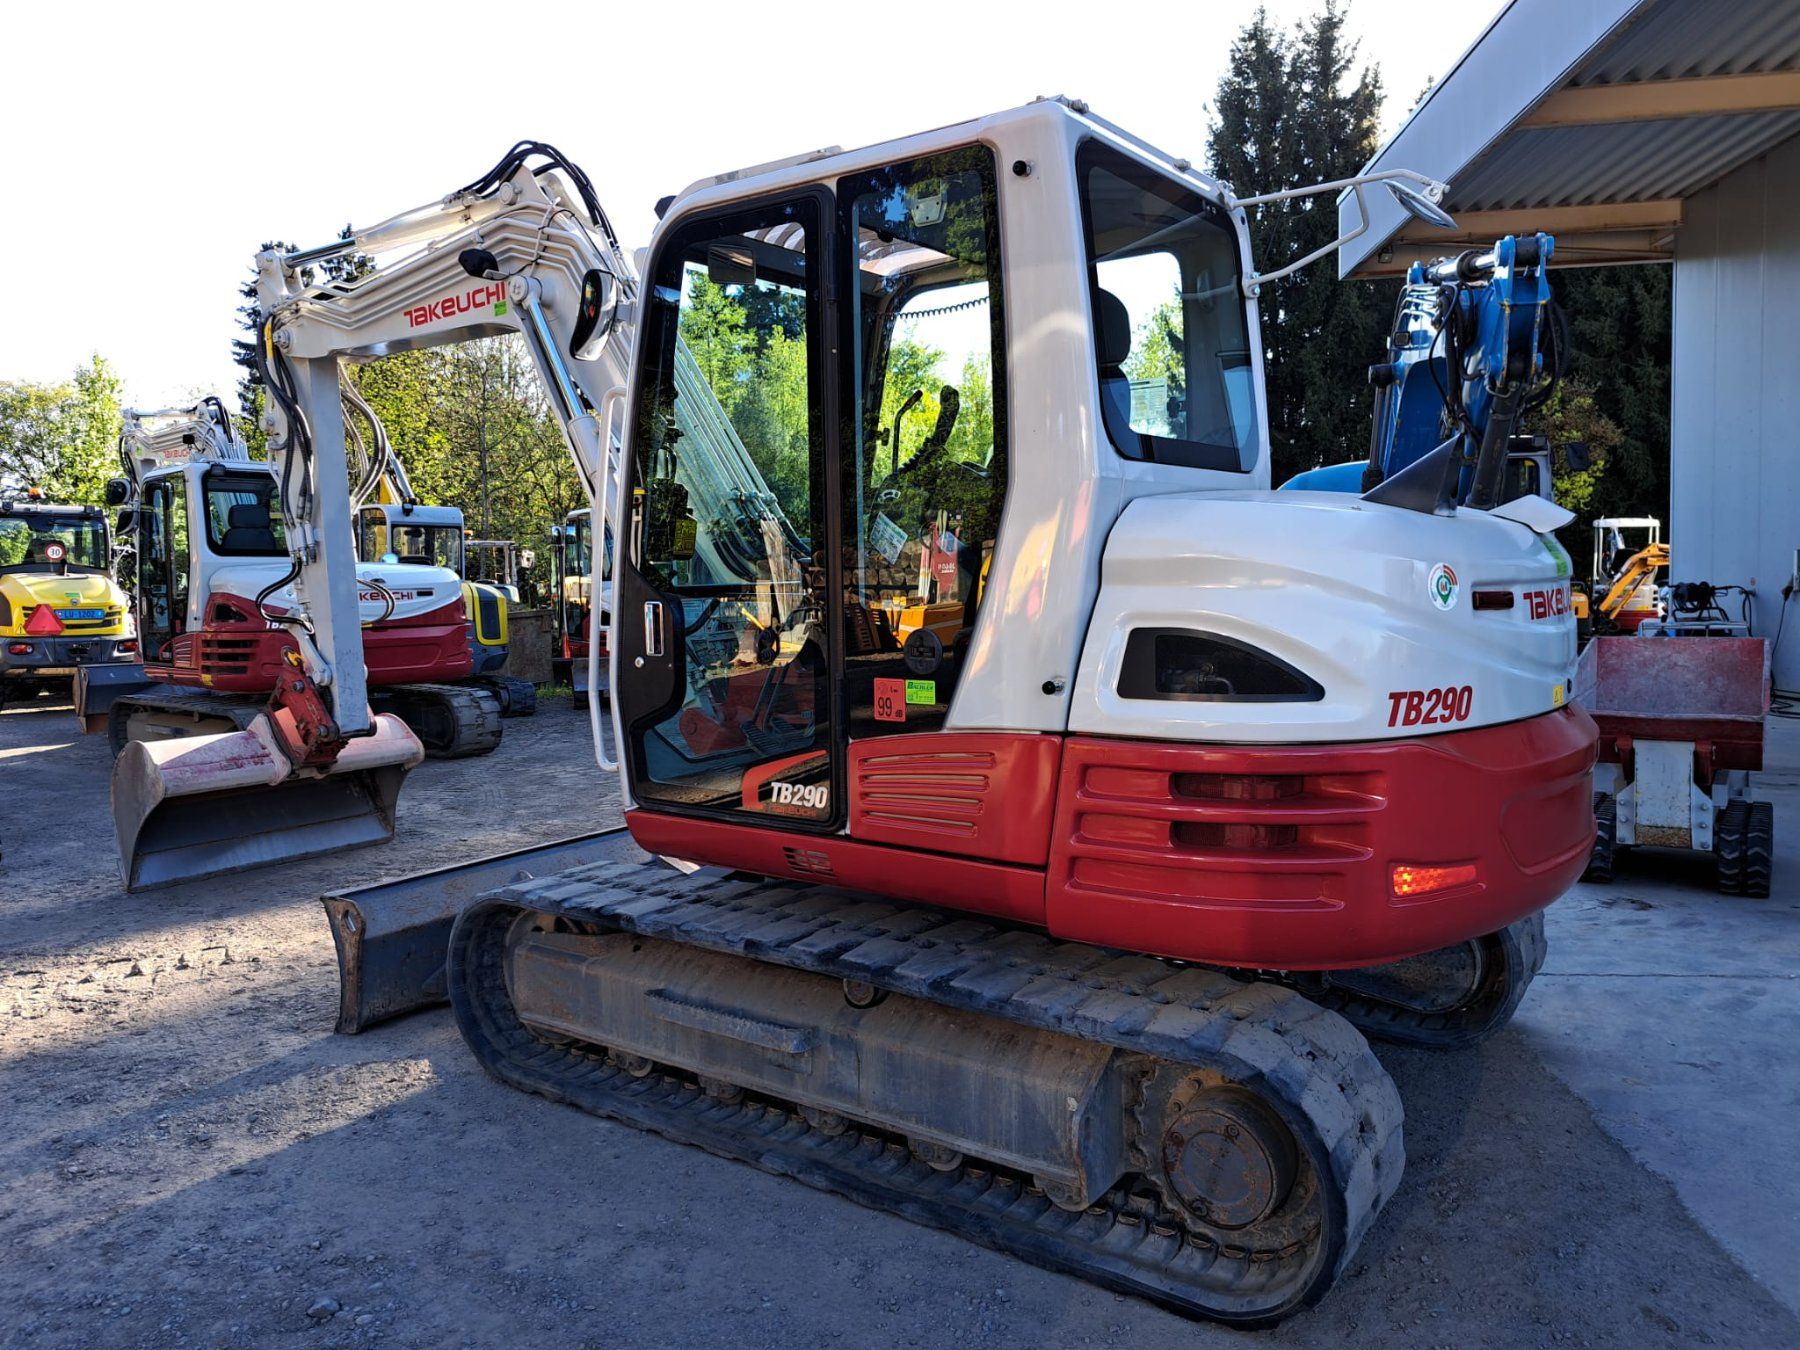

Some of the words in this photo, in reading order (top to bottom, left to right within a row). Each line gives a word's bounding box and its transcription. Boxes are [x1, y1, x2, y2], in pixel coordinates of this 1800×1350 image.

[50, 548, 61, 556] 30
[877, 696, 893, 717] 99
[1387, 685, 1473, 727] TB290
[771, 781, 828, 808] TB290
